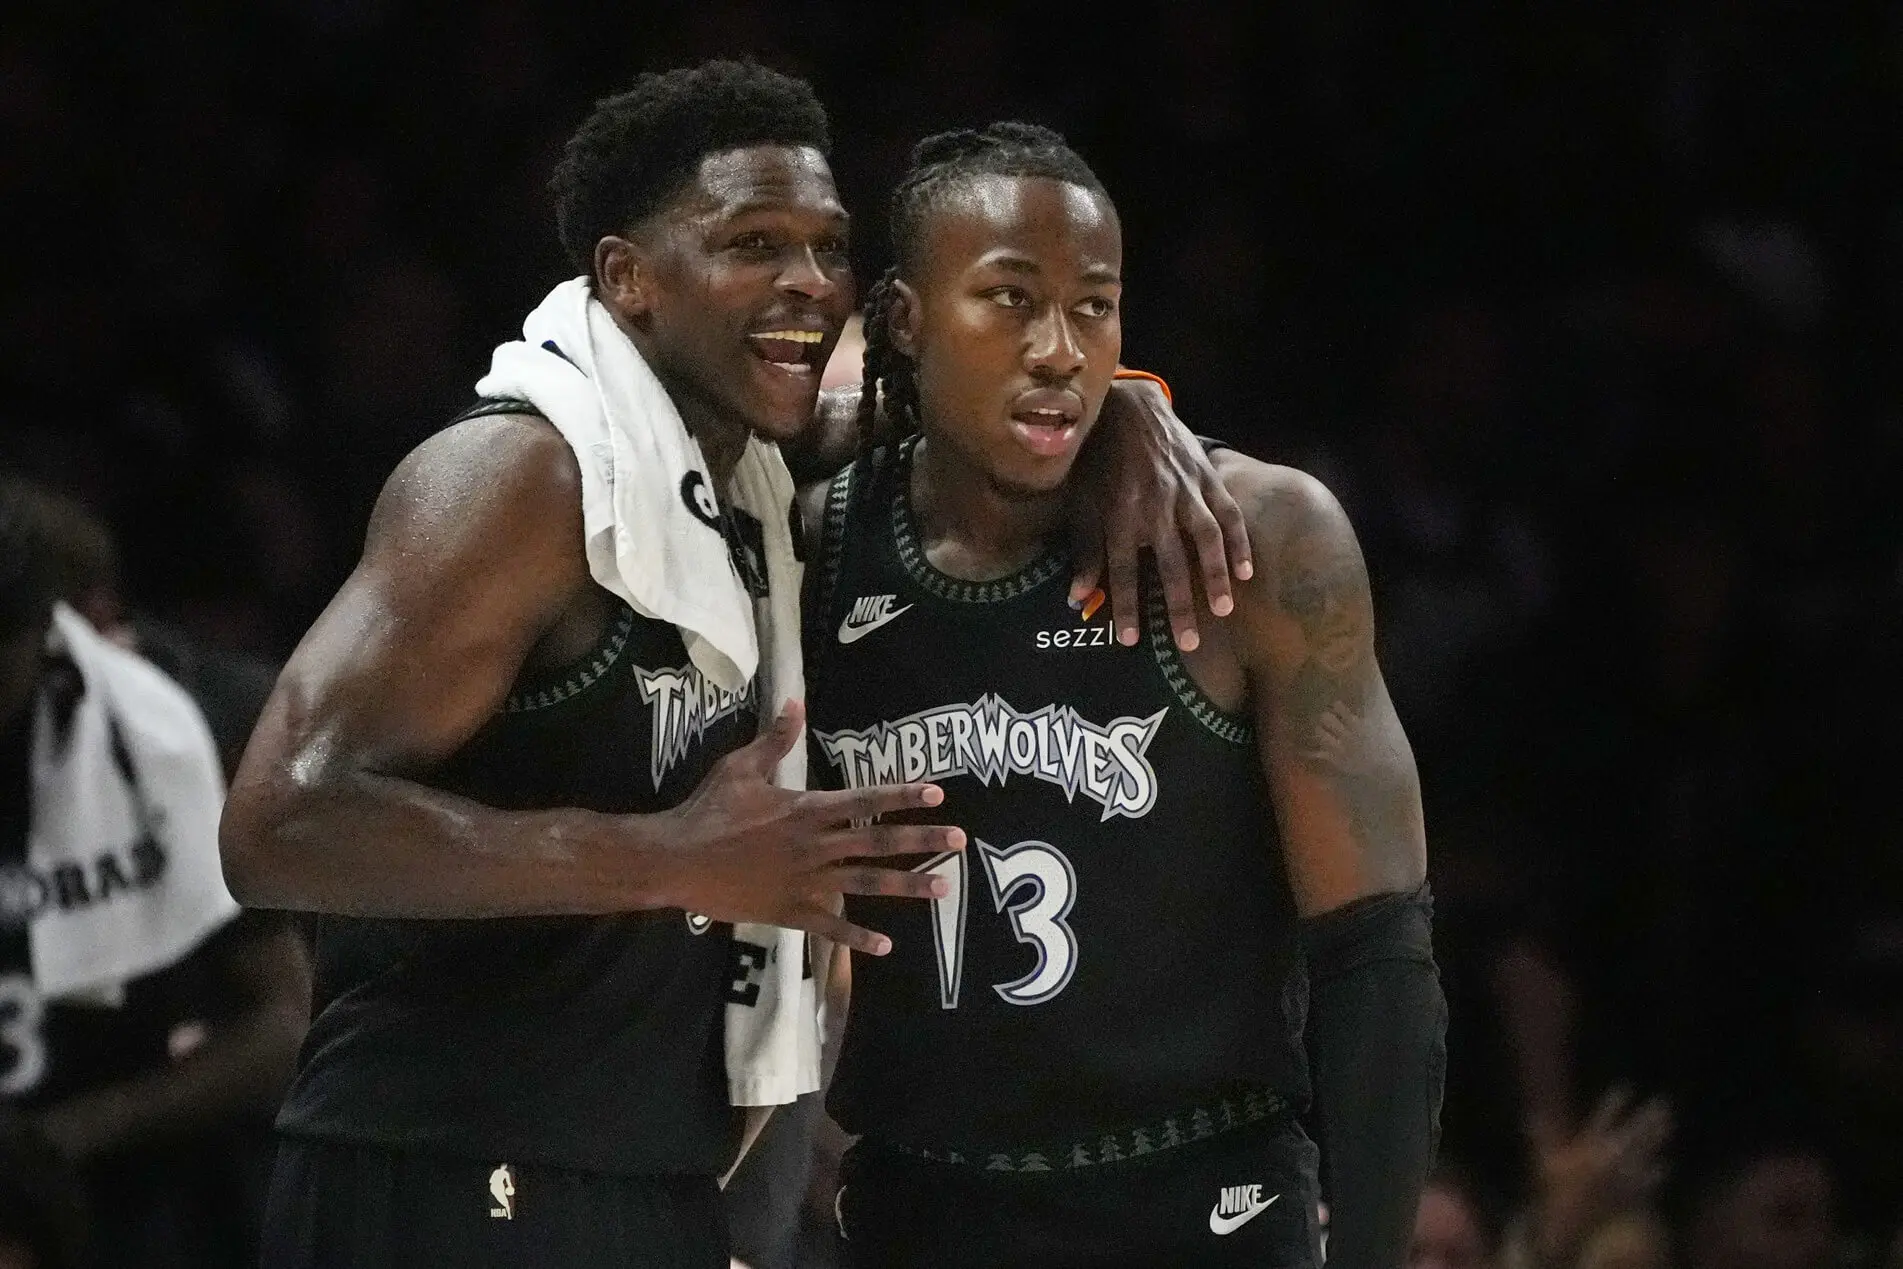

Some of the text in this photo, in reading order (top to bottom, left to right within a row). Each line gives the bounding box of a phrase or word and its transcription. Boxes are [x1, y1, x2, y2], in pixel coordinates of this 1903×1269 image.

[849, 594, 897, 623] NIKE
[1035, 620, 1114, 649] sezzl
[812, 692, 1169, 825] TIMBERWOLVES
[911, 837, 1079, 1009] 13
[1219, 1184, 1263, 1215] NIKE
